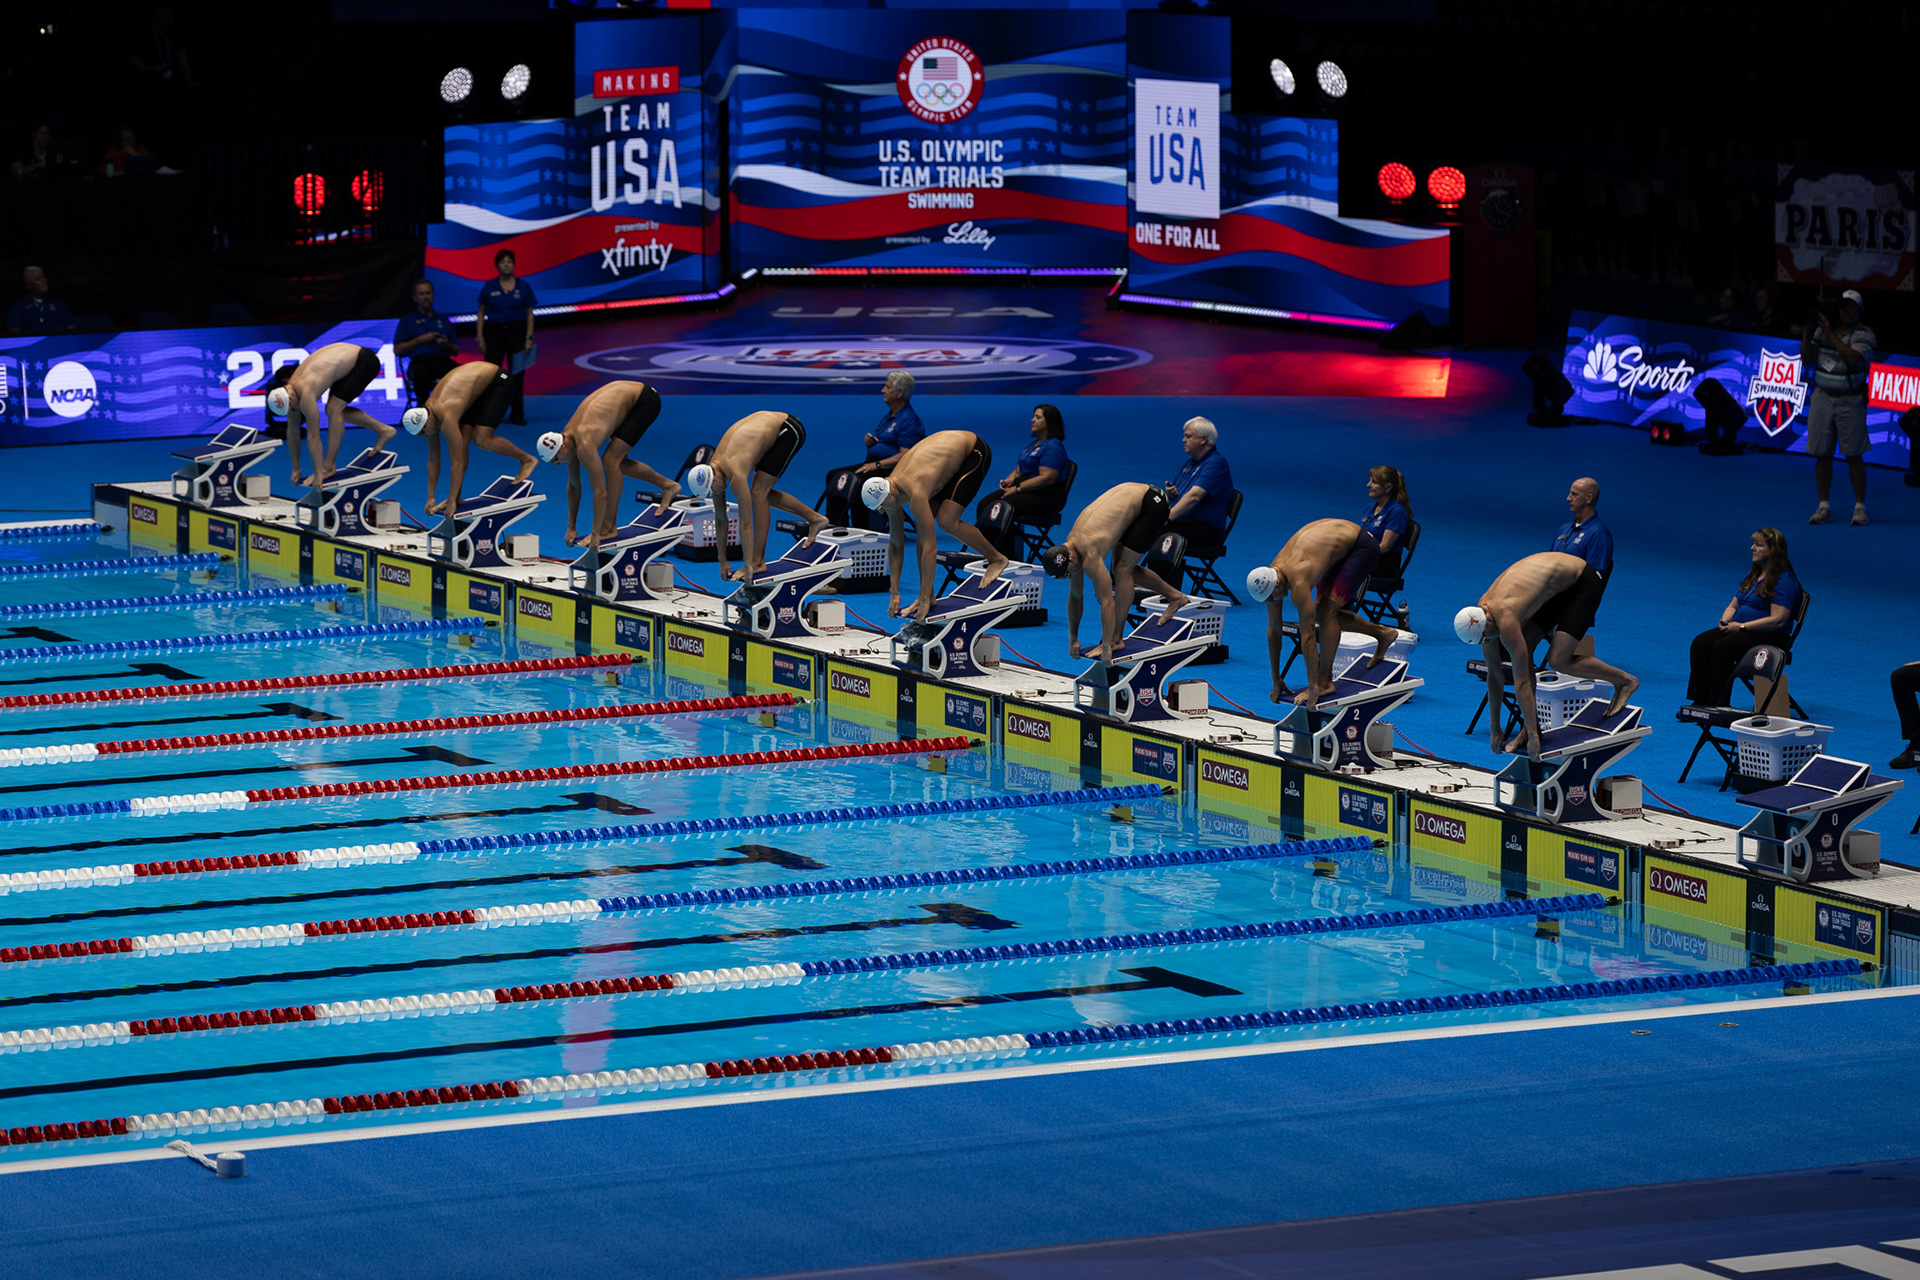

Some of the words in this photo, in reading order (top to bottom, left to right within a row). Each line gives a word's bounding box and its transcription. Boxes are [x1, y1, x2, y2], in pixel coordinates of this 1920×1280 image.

[907, 39, 939, 63] UNITED
[941, 38, 975, 63] STATES
[603, 72, 671, 92] MAKING
[603, 102, 671, 133] TEAM
[906, 99, 946, 123] OLYMPIC
[950, 100, 974, 121] TEAM
[1156, 105, 1198, 127] TEAM
[878, 139, 916, 162] U.S.
[921, 139, 1004, 162] OLYMPIC
[1150, 133, 1205, 191] USA
[591, 137, 682, 213] USA
[878, 166, 931, 188] TEAM
[936, 166, 1004, 188] TRIALS
[908, 192, 974, 209] SWIMMING
[943, 221, 996, 251] Lilly
[1135, 222, 1163, 246] ONE
[1165, 226, 1192, 248] FOR
[1194, 229, 1221, 251] ALL
[1785, 204, 1908, 252] PARIS
[601, 237, 673, 276] xfinity
[770, 306, 1055, 318] USA
[227, 343, 404, 409] 24
[1617, 345, 1695, 397] Sports
[1764, 361, 1795, 386] USA
[51, 389, 95, 403] NCAA
[1754, 382, 1801, 401] SWIMMING
[1871, 371, 1920, 406] MAKIN
[228, 461, 235, 472] 9
[353, 489, 360, 499] 8
[133, 505, 156, 523] OMEGA
[487, 518, 493, 529] 7
[258, 536, 280, 552] OMEGA
[632, 551, 639, 561] 6
[387, 567, 410, 584] OMEGA
[790, 585, 797, 596] 5
[527, 600, 553, 619] OMEGA
[961, 622, 967, 633] 4
[677, 636, 704, 655] OMEGA
[1150, 664, 1157, 675] 3
[840, 676, 870, 695] OMEGA
[1353, 709, 1360, 720] 2
[1018, 719, 1051, 739] OMEGA
[1582, 757, 1588, 770] 1
[1213, 766, 1248, 788] OMEGA
[1284, 787, 1301, 797] OMEGA
[1621, 807, 1642, 815] OMEGA
[1832, 813, 1838, 826] 0
[1427, 817, 1466, 841] OMEGA
[1505, 841, 1523, 852] OMEGA
[1664, 875, 1707, 900] OMEGA
[1751, 900, 1770, 912] OMEGA
